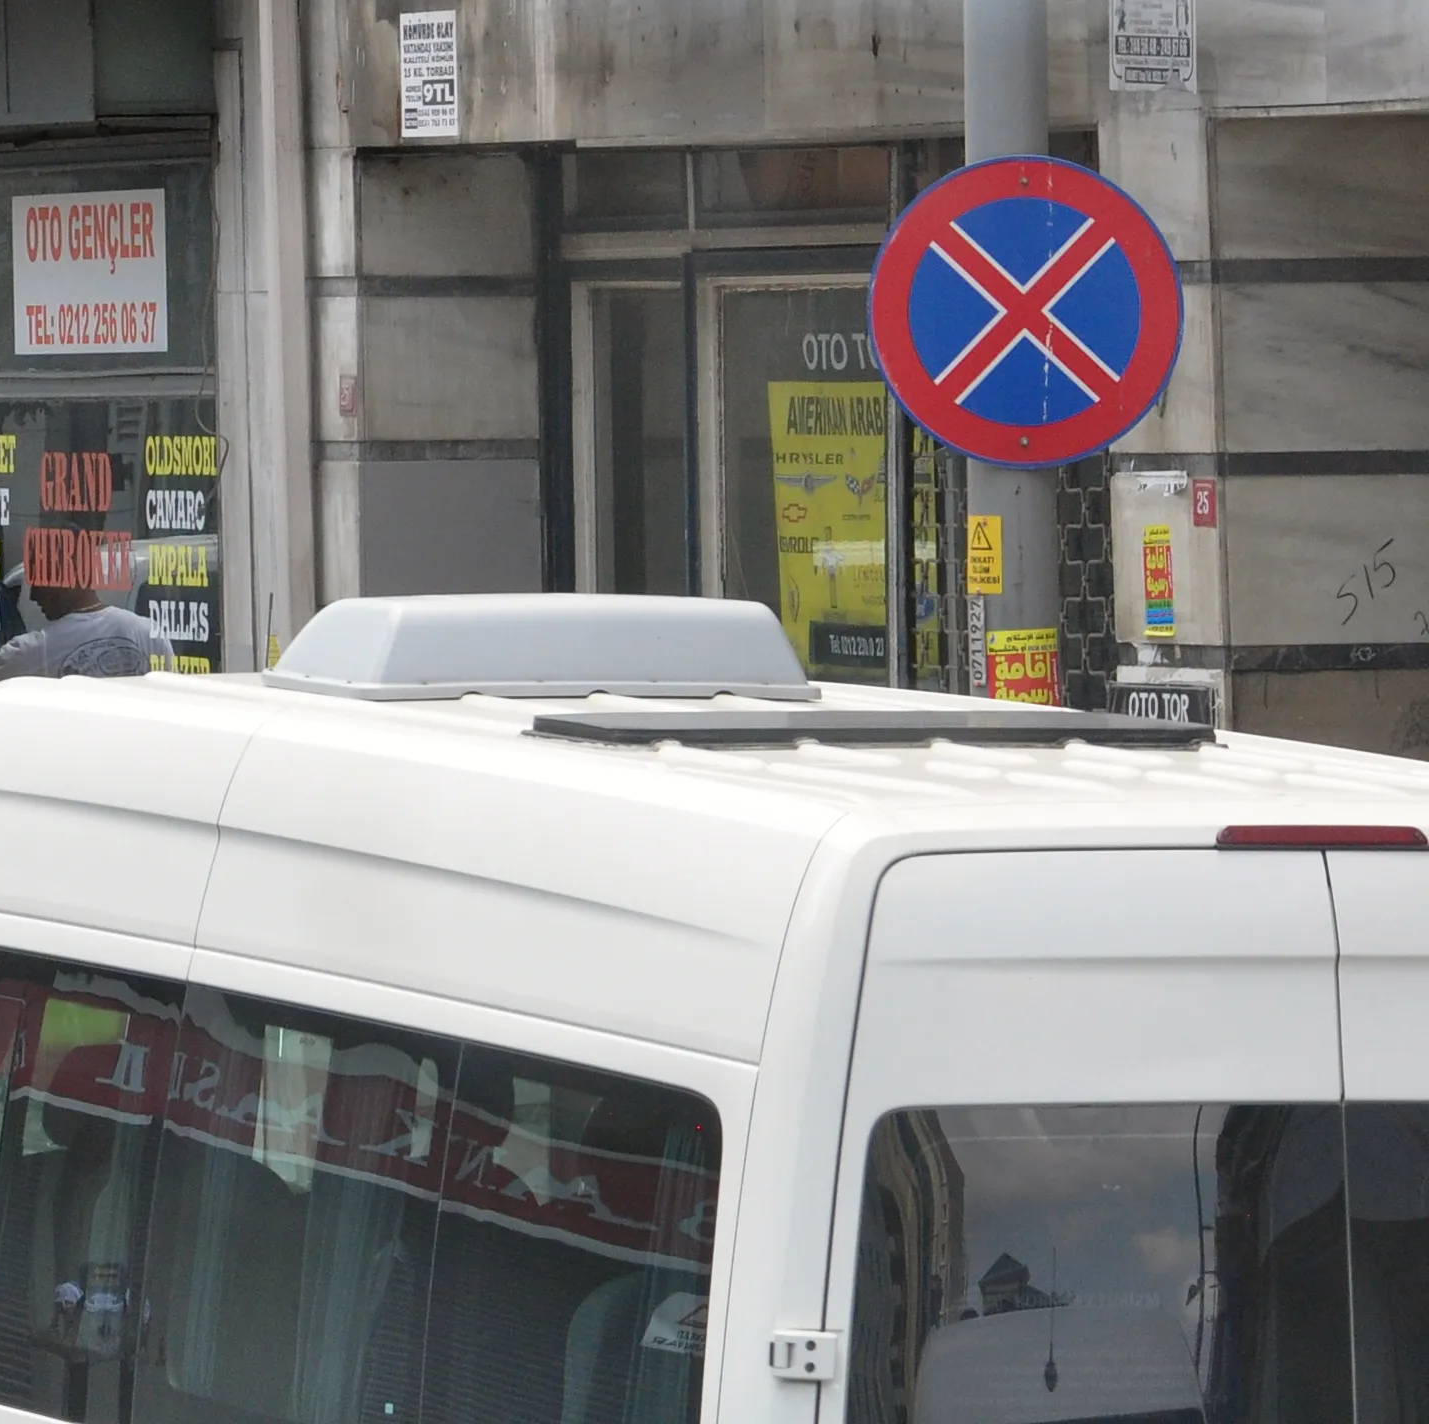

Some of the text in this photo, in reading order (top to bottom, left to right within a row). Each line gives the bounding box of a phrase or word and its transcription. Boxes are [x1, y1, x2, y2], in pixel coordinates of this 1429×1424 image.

[423, 83, 454, 103] 9TL
[26, 201, 155, 275] OTO GENÇLER
[26, 301, 157, 345] TEL: 0212 256 06 37
[802, 332, 848, 371] OTO
[849, 396, 884, 436] ARAB
[40, 451, 113, 512] GRAND
[1196, 491, 1209, 515] 25
[23, 528, 134, 591] CHEROKEE
[148, 544, 209, 587] IMPALA
[149, 601, 209, 643] DALLAS
[1128, 691, 1190, 723] OTO TOR
